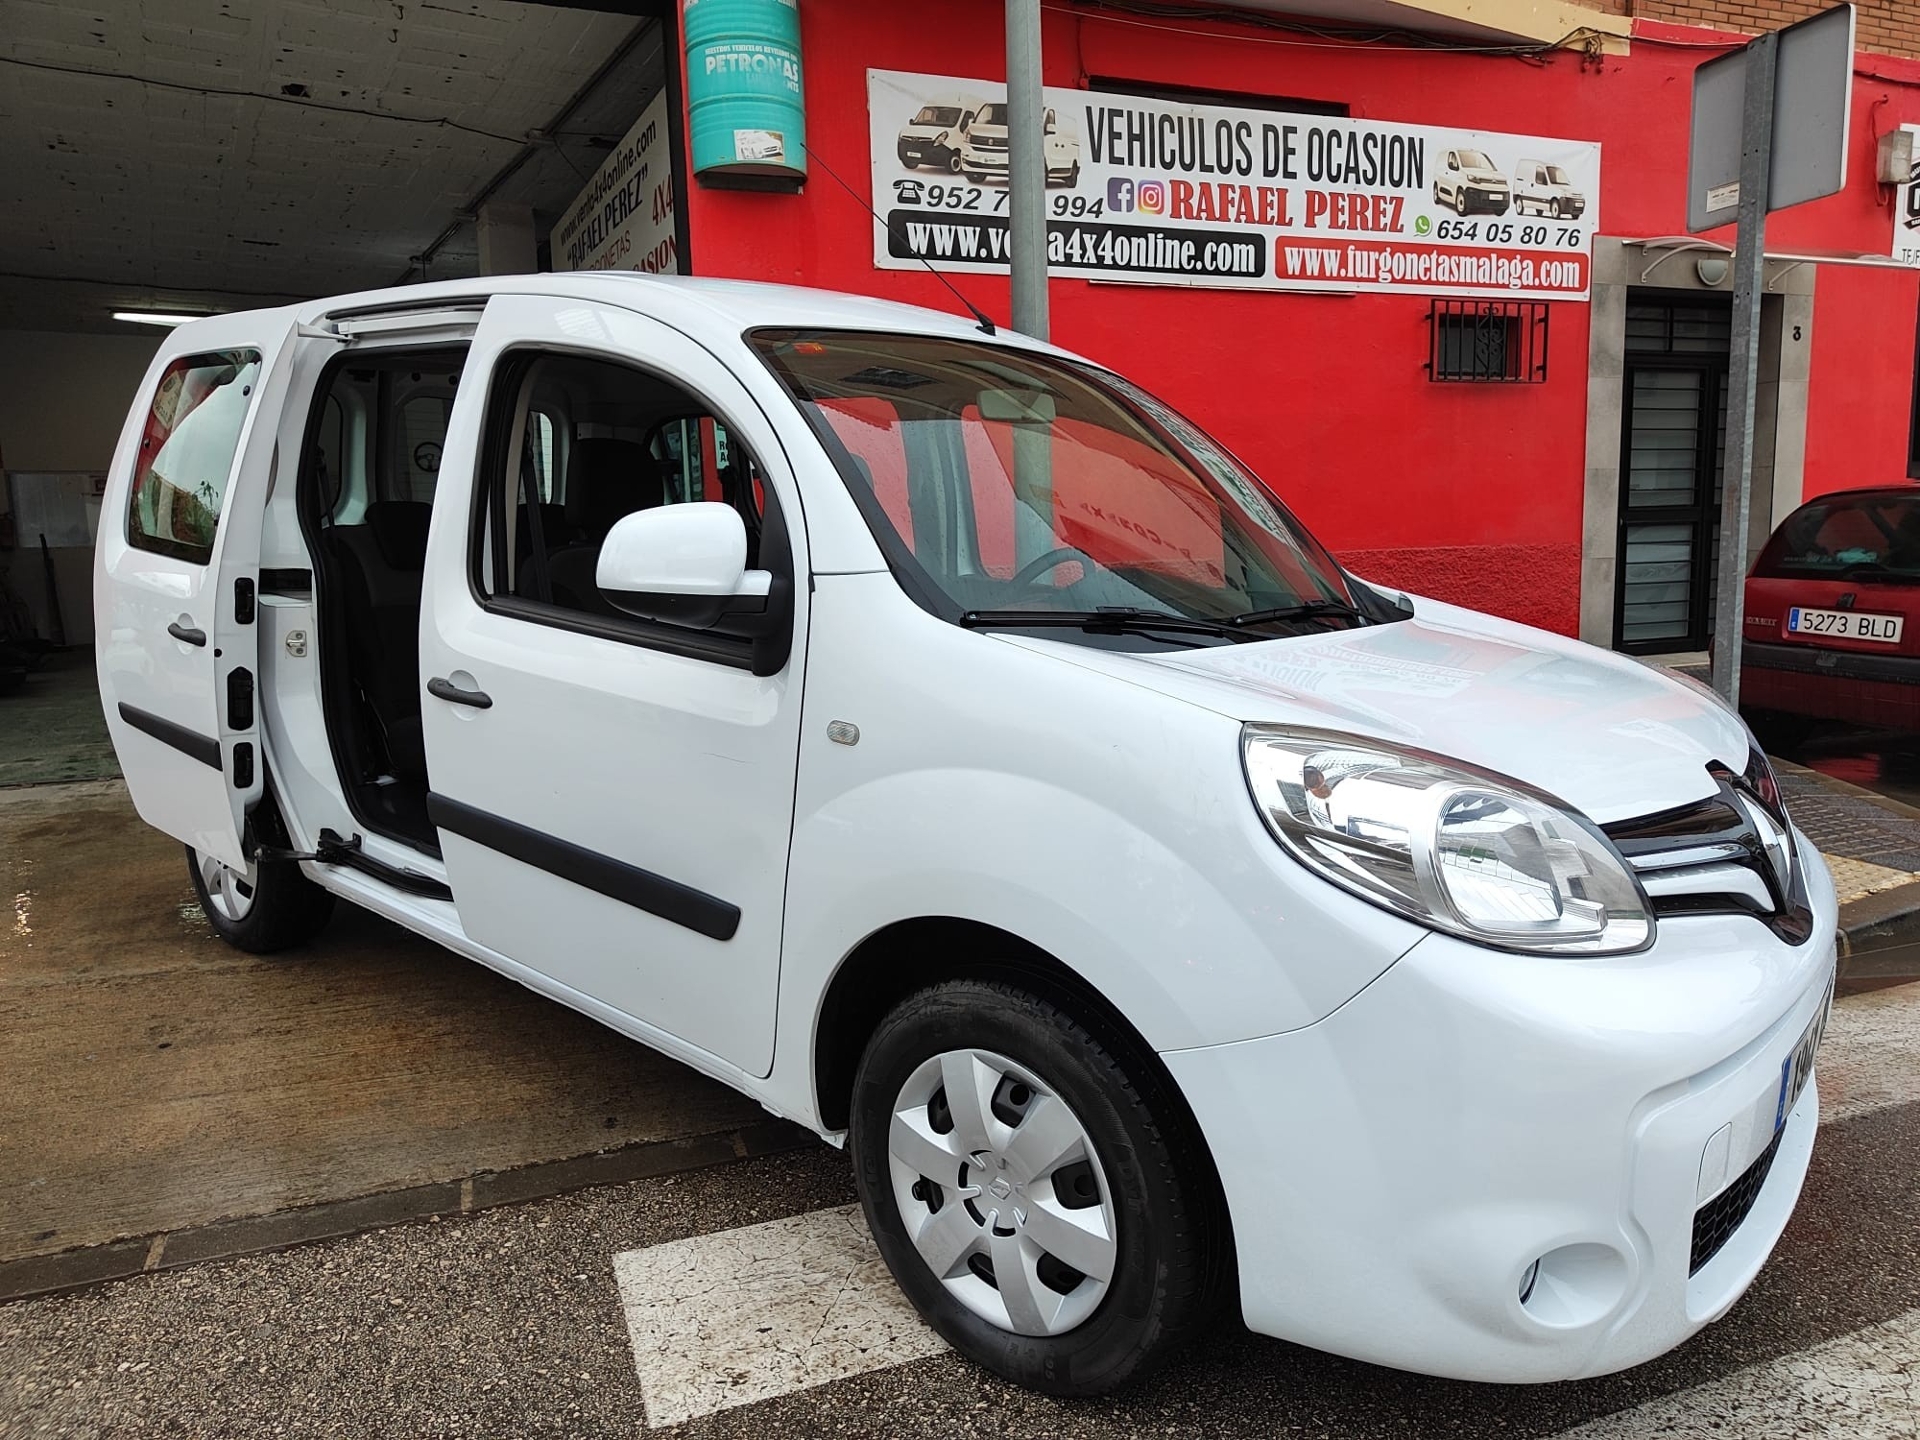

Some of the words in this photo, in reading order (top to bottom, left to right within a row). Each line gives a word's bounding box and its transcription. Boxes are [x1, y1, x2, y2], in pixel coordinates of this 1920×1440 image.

[705, 53, 799, 82] PETRONAS
[1086, 105, 1253, 177] VEHICULOS
[1262, 123, 1298, 180] DE
[1307, 127, 1424, 189] OCASION
[926, 184, 982, 211] 952
[1052, 194, 1104, 219] 994
[1169, 179, 1294, 227] RAFAEL
[1304, 188, 1405, 233] PEREZ
[905, 222, 1256, 274] www.va4x4online.com
[1436, 219, 1478, 241] 654
[1485, 222, 1513, 244] 05
[1520, 225, 1547, 245] 80
[1555, 227, 1581, 248] 76
[1284, 245, 1580, 290] www.furgonetasmalaga.com
[1792, 325, 1802, 342] 3
[1803, 612, 1849, 633] 5273
[1858, 618, 1897, 639] BLD
